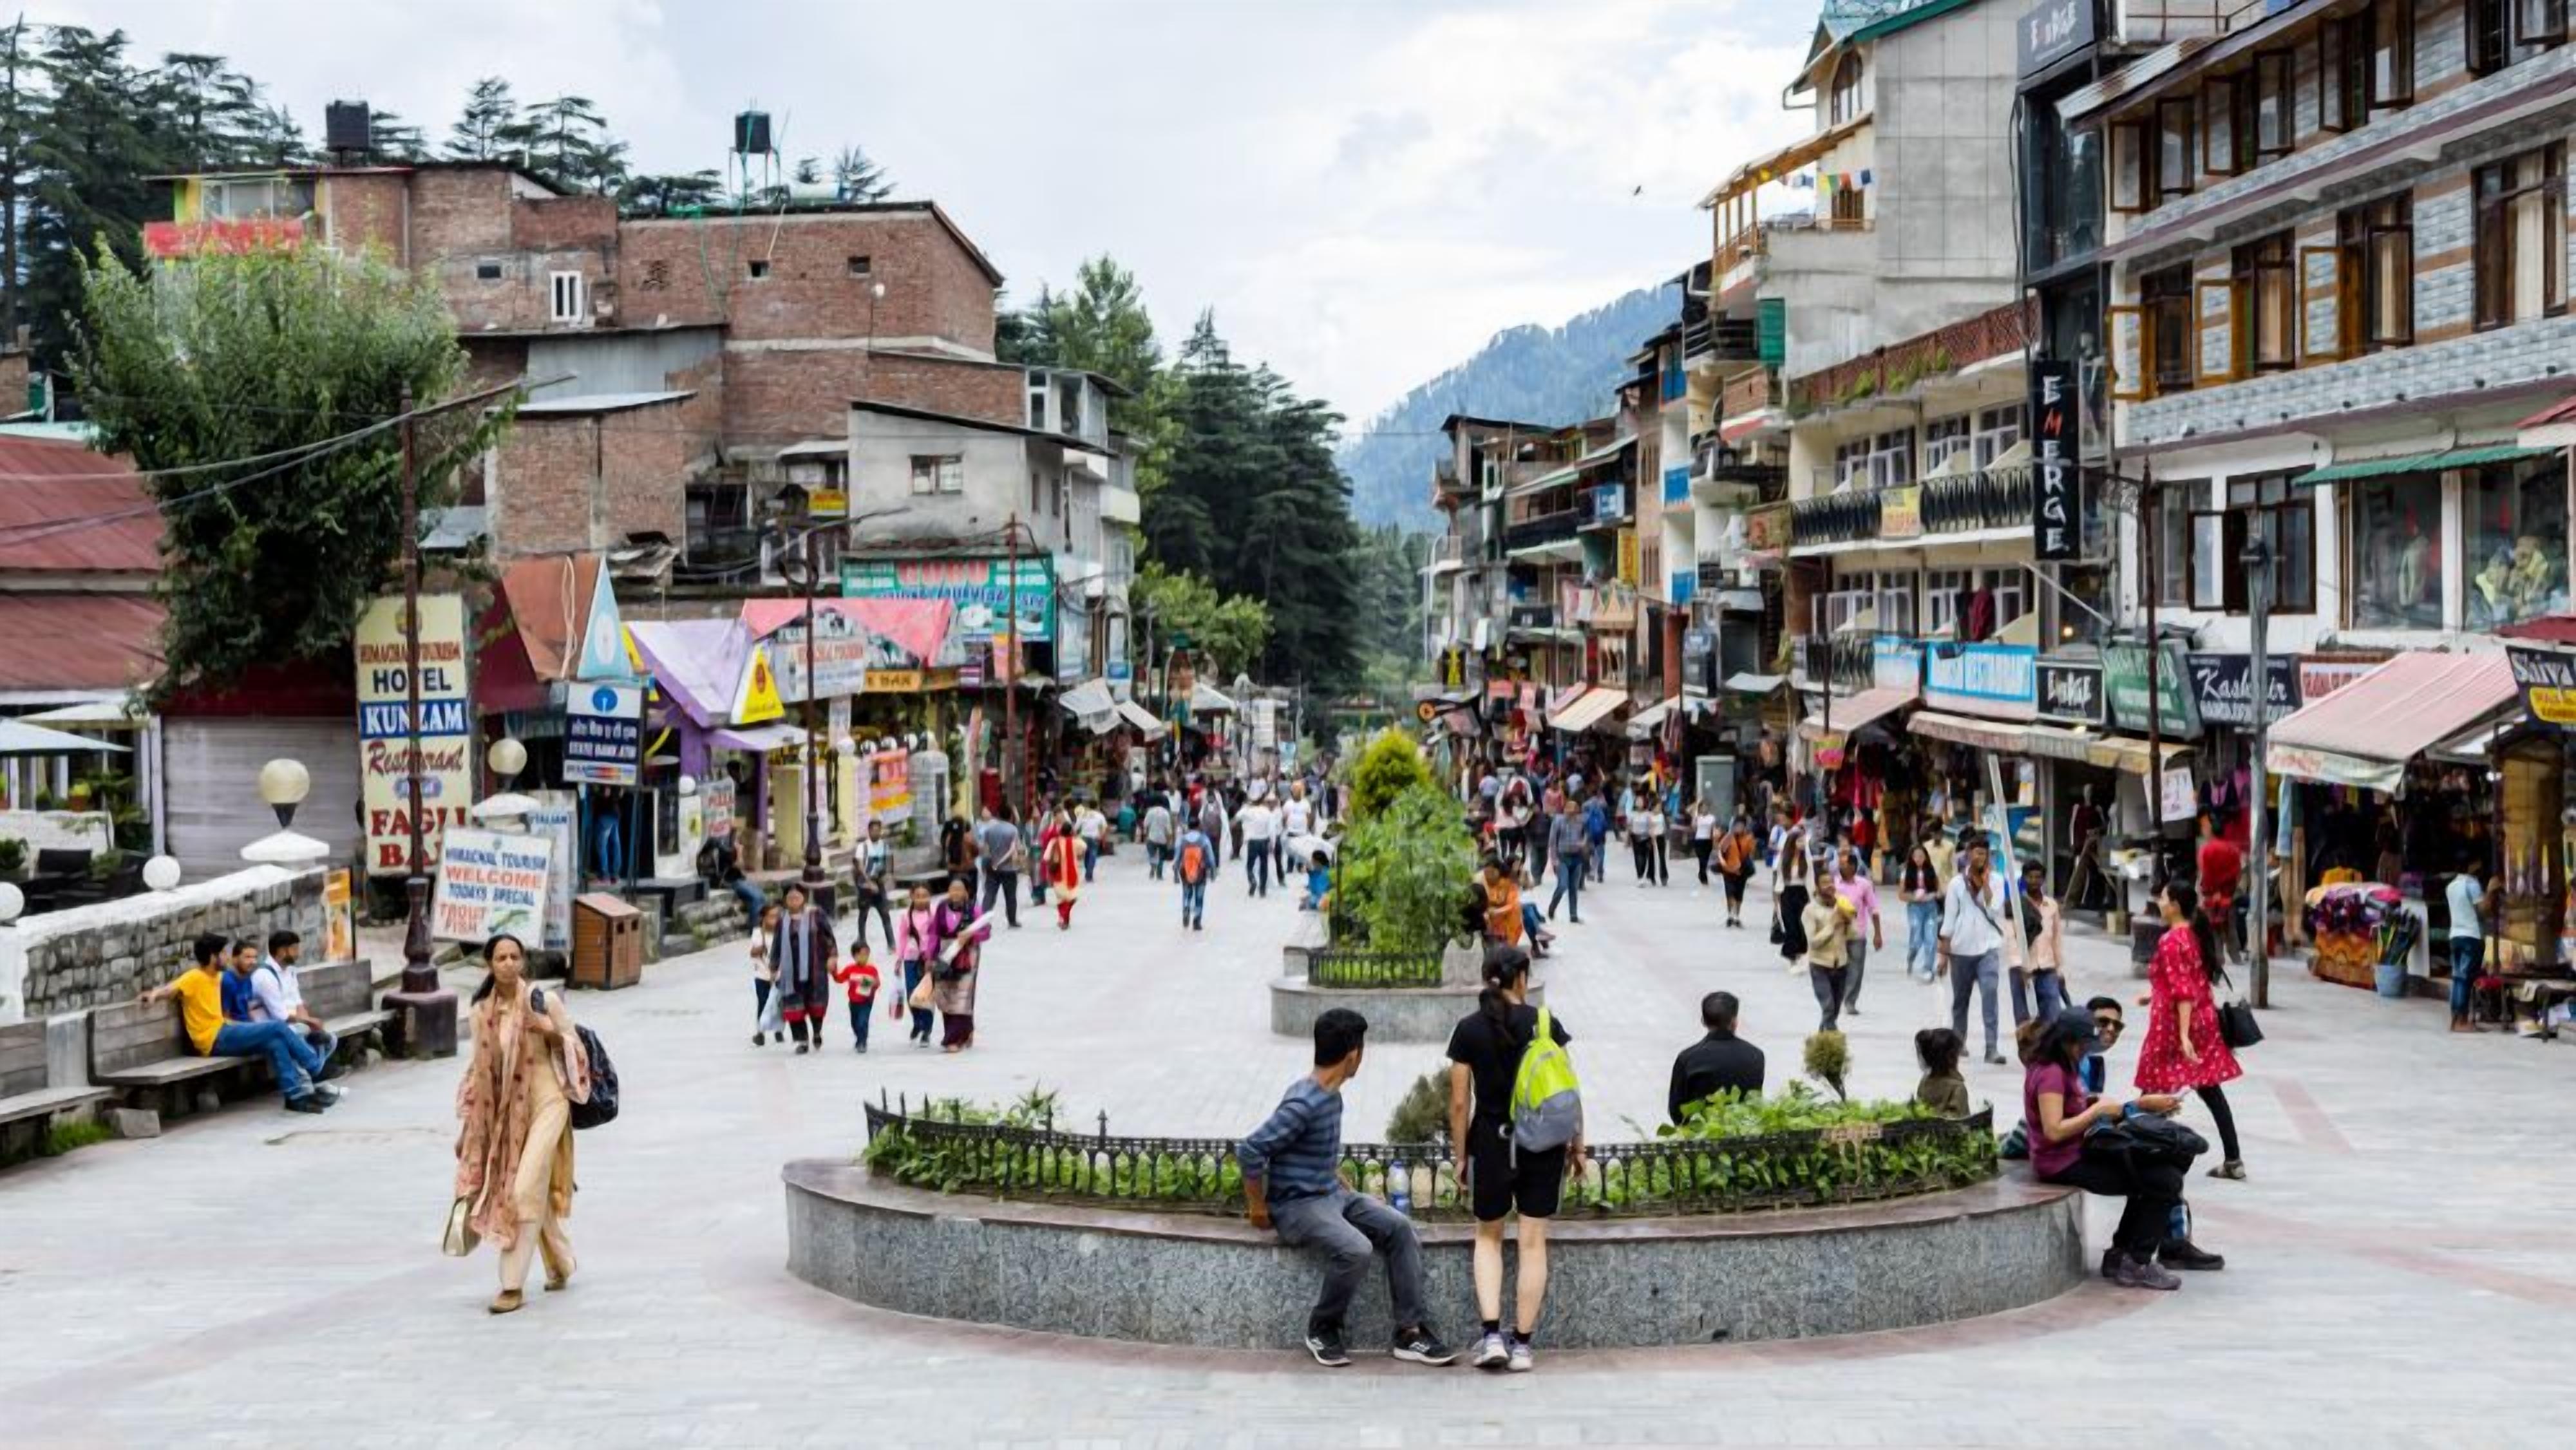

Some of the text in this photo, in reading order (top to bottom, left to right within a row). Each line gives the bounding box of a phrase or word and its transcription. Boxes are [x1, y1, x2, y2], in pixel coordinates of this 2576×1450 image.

[373, 667, 452, 693] HOEL
[2197, 667, 2287, 701] Kashir
[446, 865, 541, 889] WELCOME
